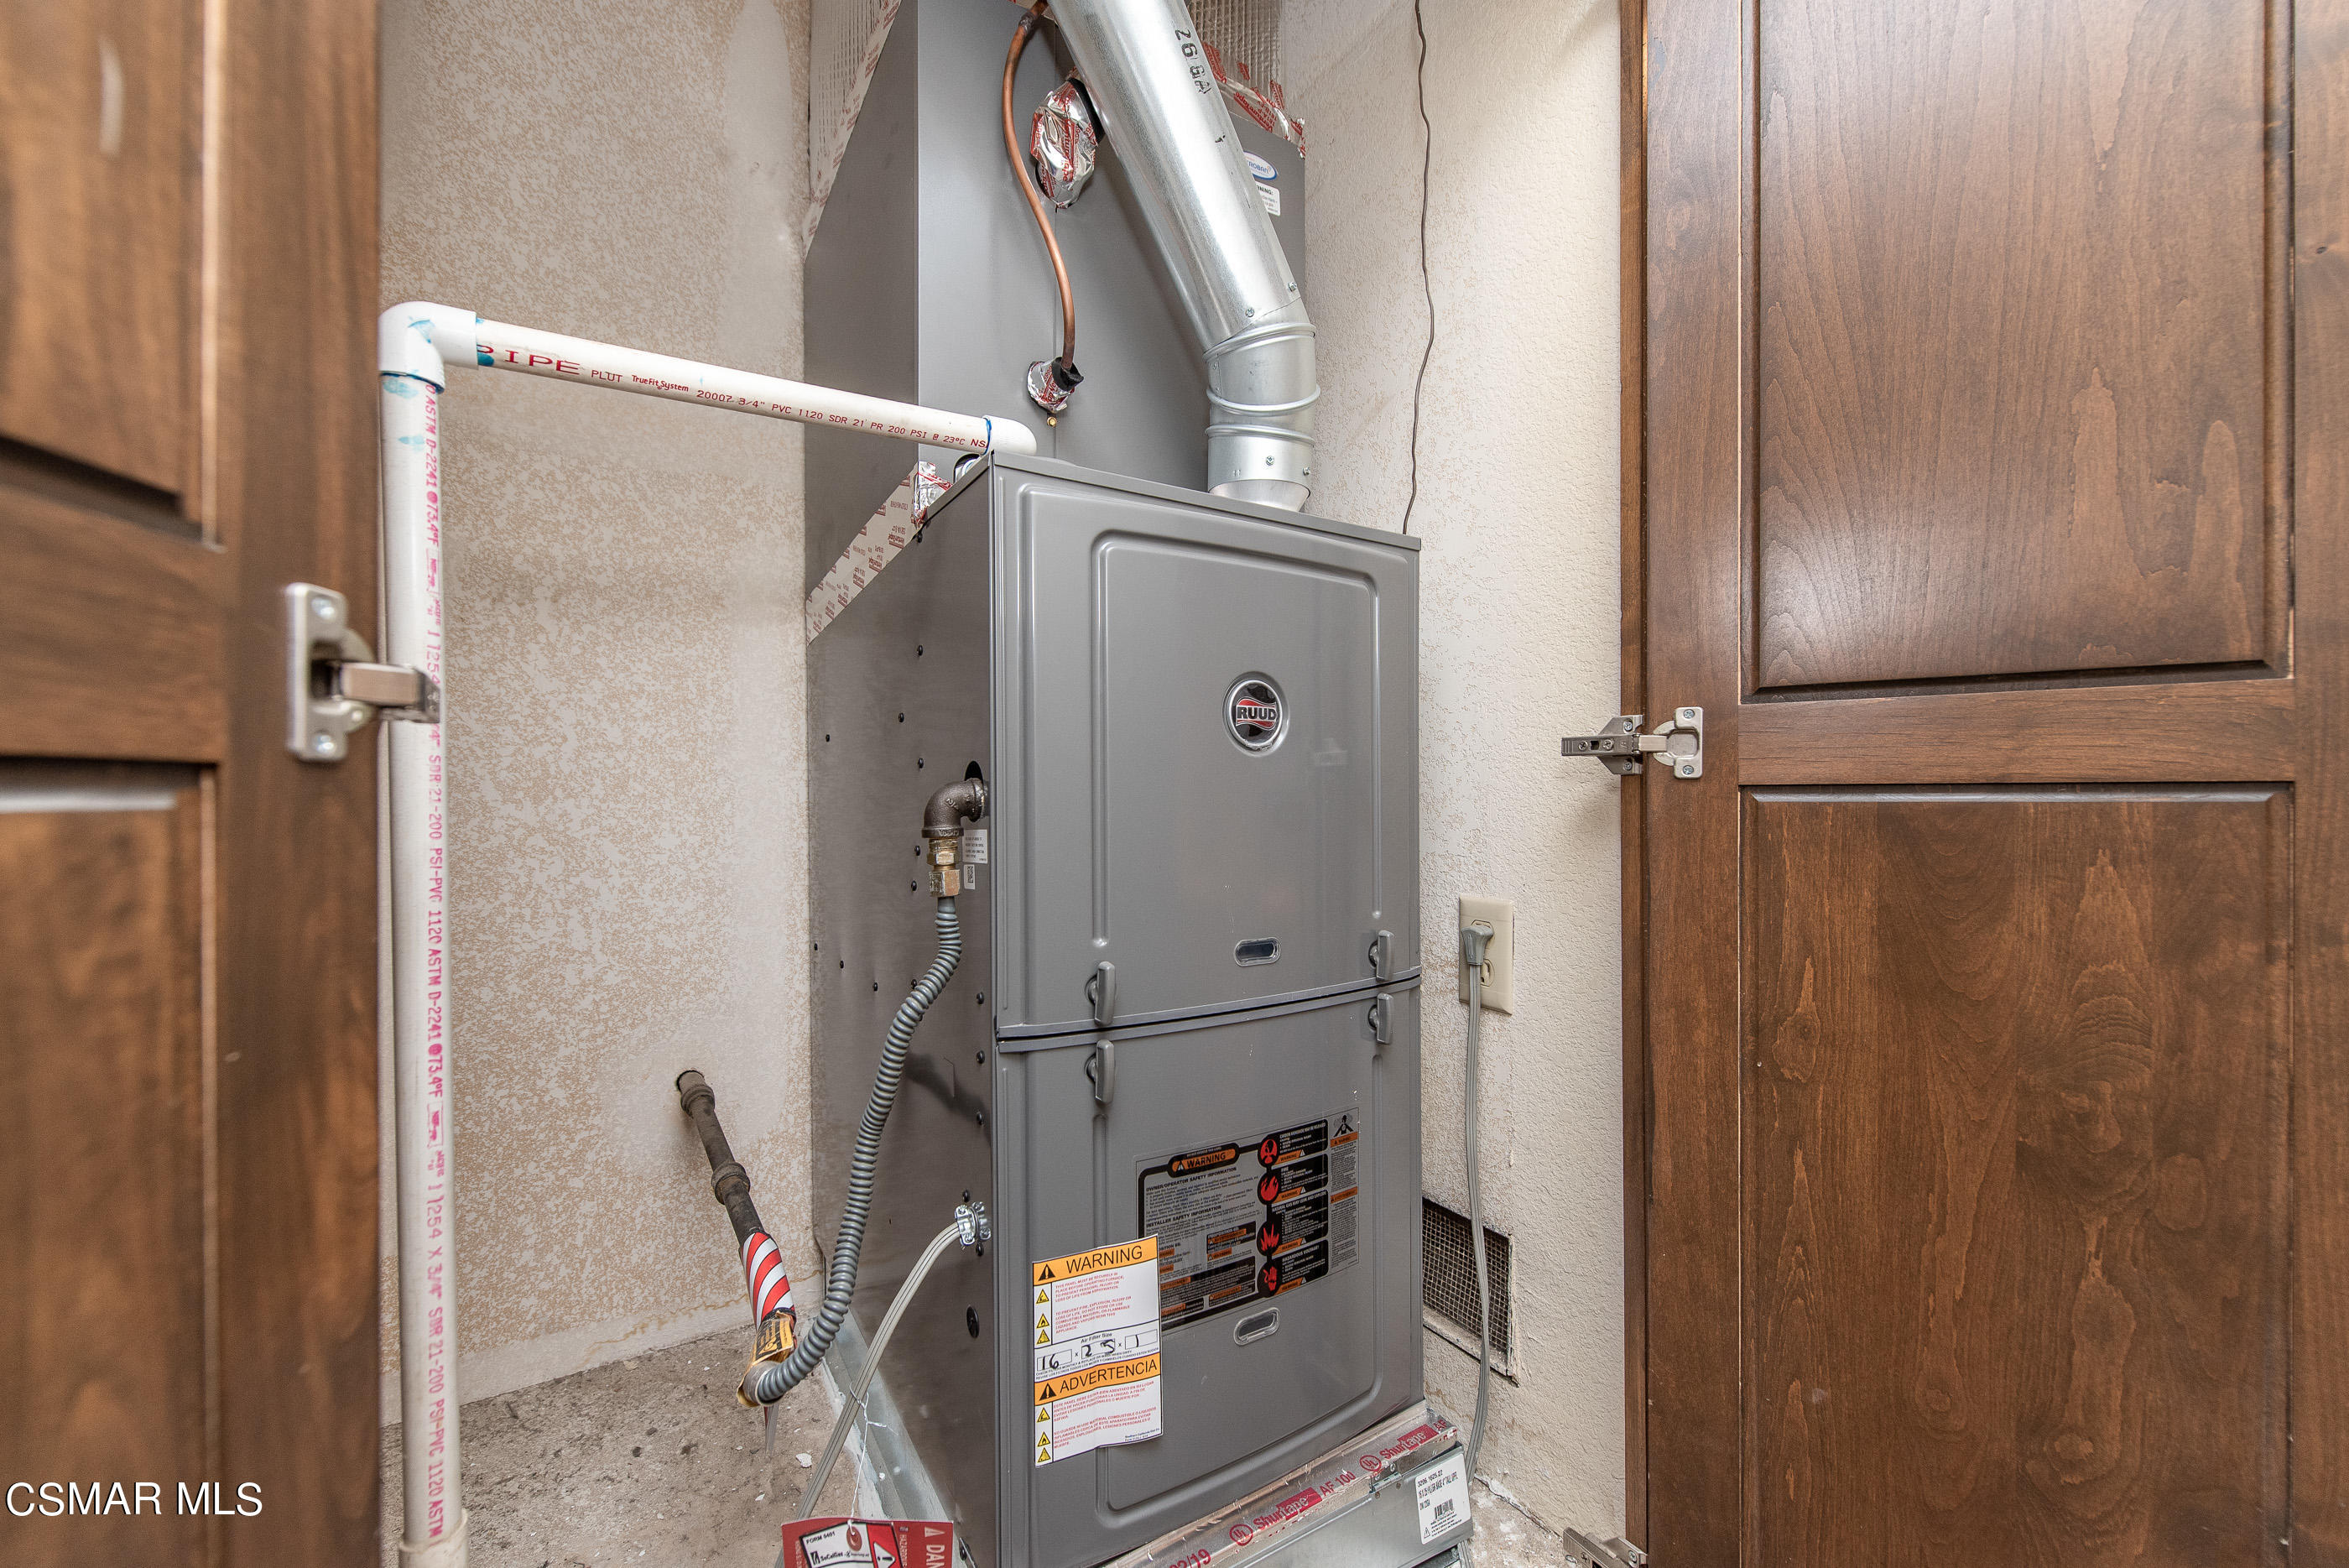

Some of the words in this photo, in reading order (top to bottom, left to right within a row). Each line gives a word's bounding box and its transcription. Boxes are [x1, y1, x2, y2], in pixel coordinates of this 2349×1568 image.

[591, 370, 622, 383] PLUT
[696, 390, 732, 403] 20007
[738, 397, 765, 409] 3/4"
[771, 404, 791, 414] PVC
[799, 409, 823, 419] 1120
[828, 414, 847, 425] SDR
[852, 419, 864, 427] 21
[871, 422, 883, 430] PR
[888, 426, 906, 435] 200
[909, 430, 927, 439] PSI
[971, 439, 988, 449] NS
[1237, 706, 1277, 720] RUUD
[1186, 1152, 1227, 1168] WARNING
[1066, 1245, 1143, 1274] WARNING
[1042, 1353, 1059, 1370] 16
[1060, 1358, 1157, 1393] ADVERTENCIA
[1379, 1431, 1426, 1460] Shurtape
[1253, 1496, 1310, 1529] Shurtape
[1319, 1481, 1335, 1497] AF
[1336, 1471, 1357, 1486] 100
